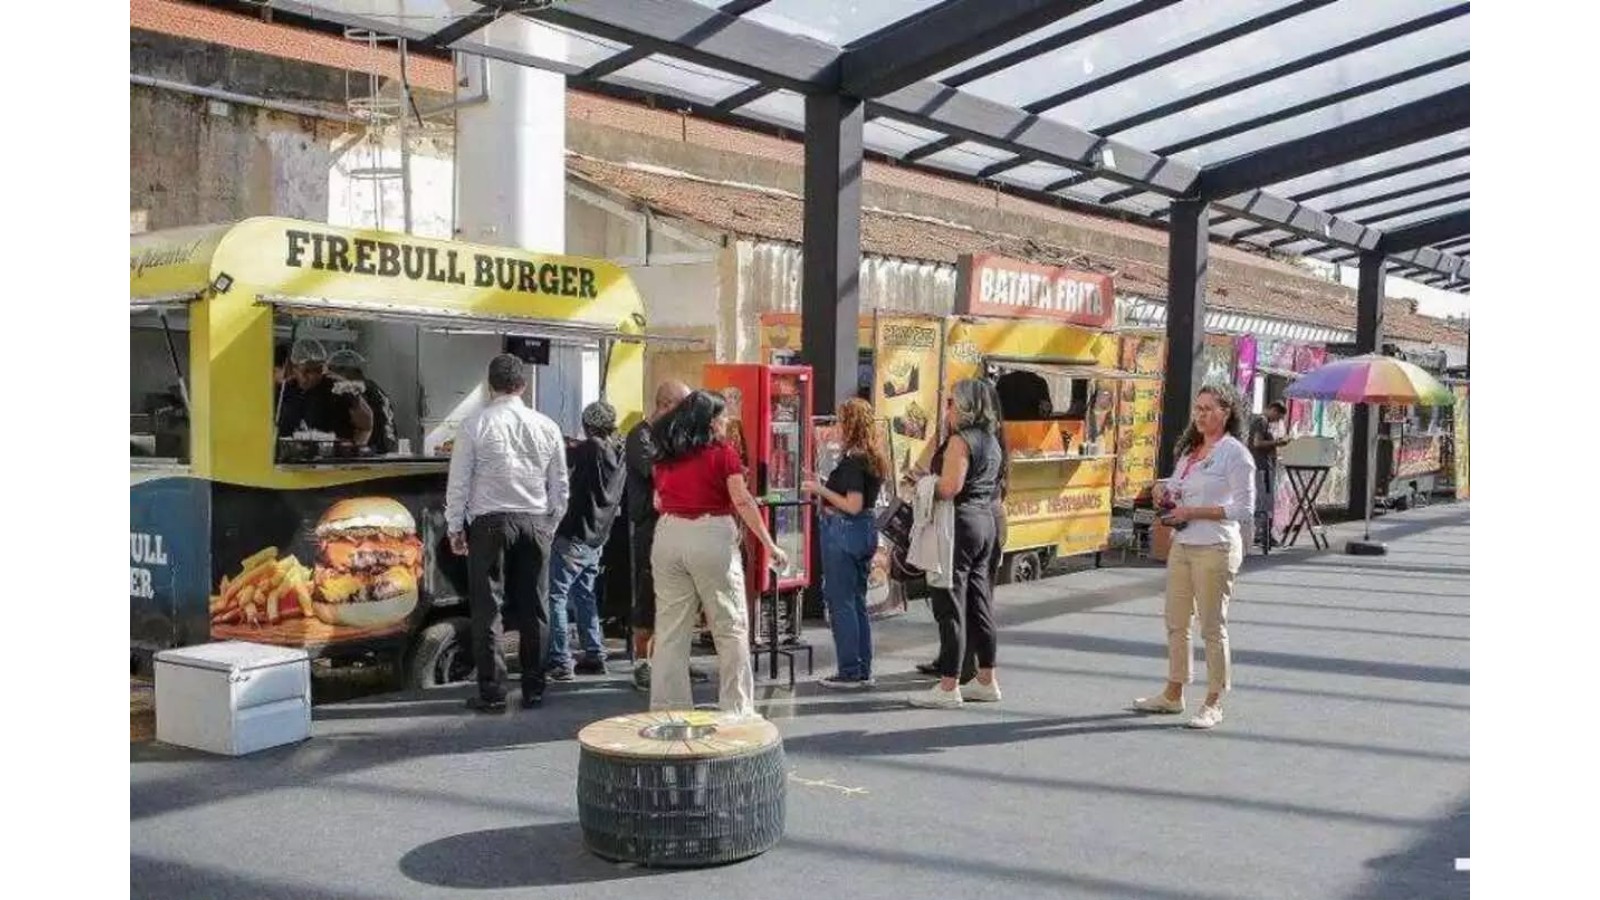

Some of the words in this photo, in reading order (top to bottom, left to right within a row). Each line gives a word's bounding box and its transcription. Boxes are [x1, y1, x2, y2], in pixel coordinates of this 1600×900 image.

[285, 229, 466, 285] FIREBULL
[474, 254, 598, 299] BURGER
[979, 266, 1053, 310] BATATA
[1056, 276, 1104, 315] FRITA
